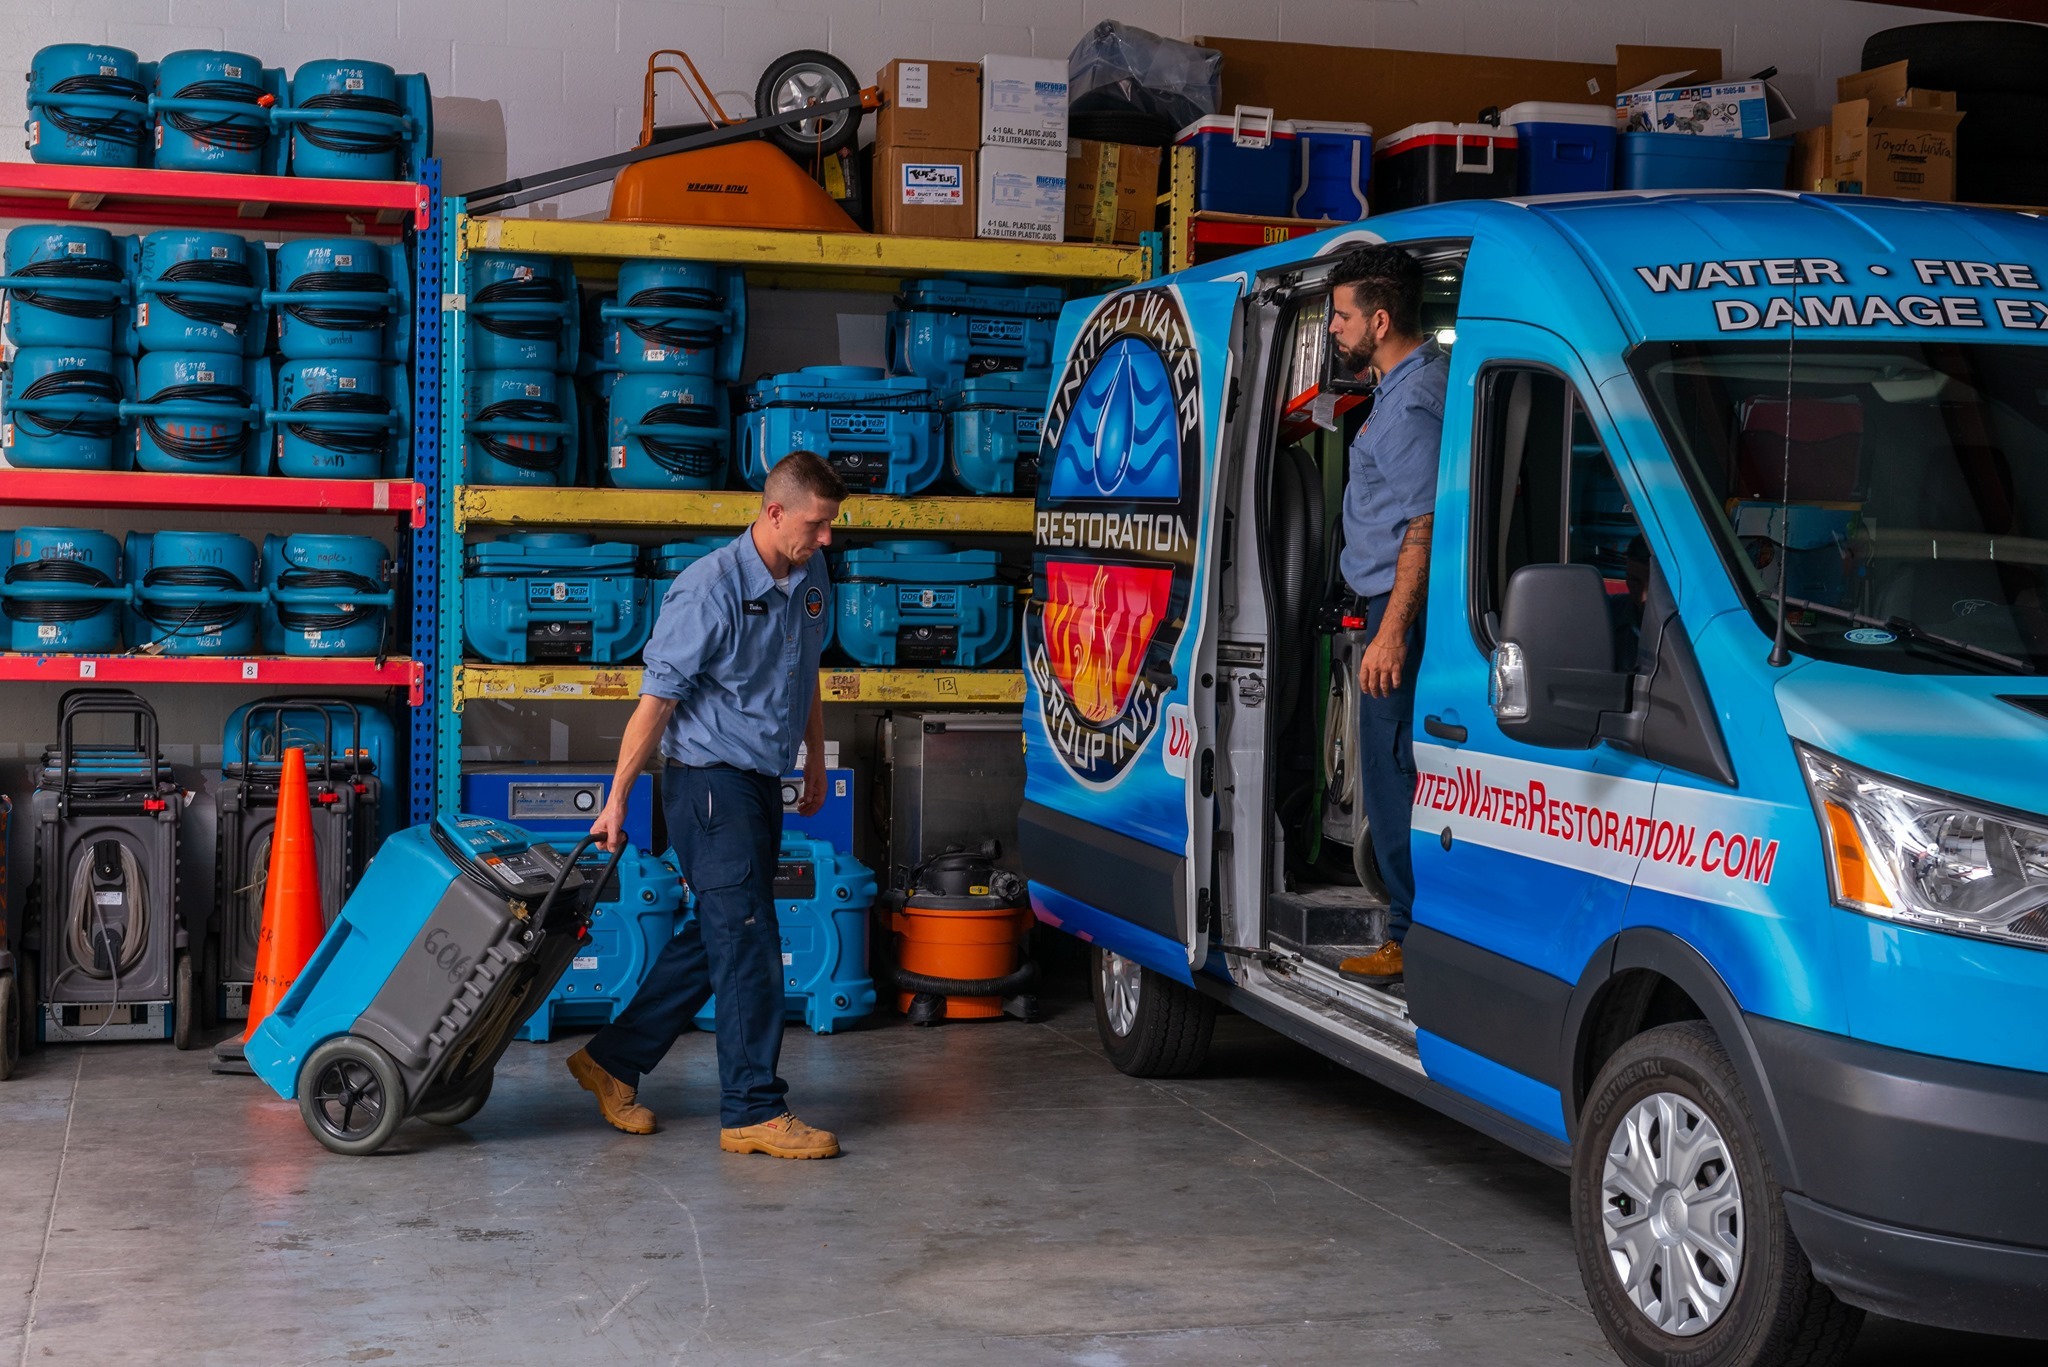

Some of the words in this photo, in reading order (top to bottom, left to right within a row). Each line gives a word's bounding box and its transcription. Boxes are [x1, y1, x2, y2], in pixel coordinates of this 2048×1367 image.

[1017, 128, 1041, 137] PLASTIC
[1041, 130, 1057, 139] JUGS
[1005, 135, 1022, 144] LITER
[1022, 137, 1046, 146] PLASTIC
[1046, 139, 1063, 148] JUGS
[1873, 132, 1917, 161] Toyota
[686, 182, 724, 193] TEMPER
[724, 183, 749, 194] TRUE
[1124, 187, 1136, 195] TOP
[1012, 221, 1036, 231] PLASTIC
[1036, 223, 1052, 232] JUGS
[1000, 229, 1017, 238] LITER
[1017, 230, 1041, 240] PLASTIC
[1041, 232, 1057, 241] JUGS
[1636, 257, 1846, 293] WATER
[1910, 257, 2041, 290] FIRE
[1714, 295, 1986, 332] DAMAGE
[971, 323, 988, 331] 500
[1005, 324, 1022, 332] HEPA
[1047, 293, 1136, 450] UNITED
[1138, 289, 1199, 443] WATER
[830, 417, 849, 426] 500
[867, 419, 885, 427] HEPA
[1018, 419, 1036, 428] 500
[1035, 511, 1189, 553] RESTORATION
[531, 587, 549, 595] 500
[569, 587, 589, 595] HEPA
[937, 593, 955, 601] HEPA
[85, 664, 92, 674] 7
[246, 666, 254, 676] 8
[832, 675, 856, 684] FORD
[942, 679, 954, 691] 13
[1033, 642, 1106, 772] GROUP
[1594, 1059, 1665, 1125] CONTINENTAL
